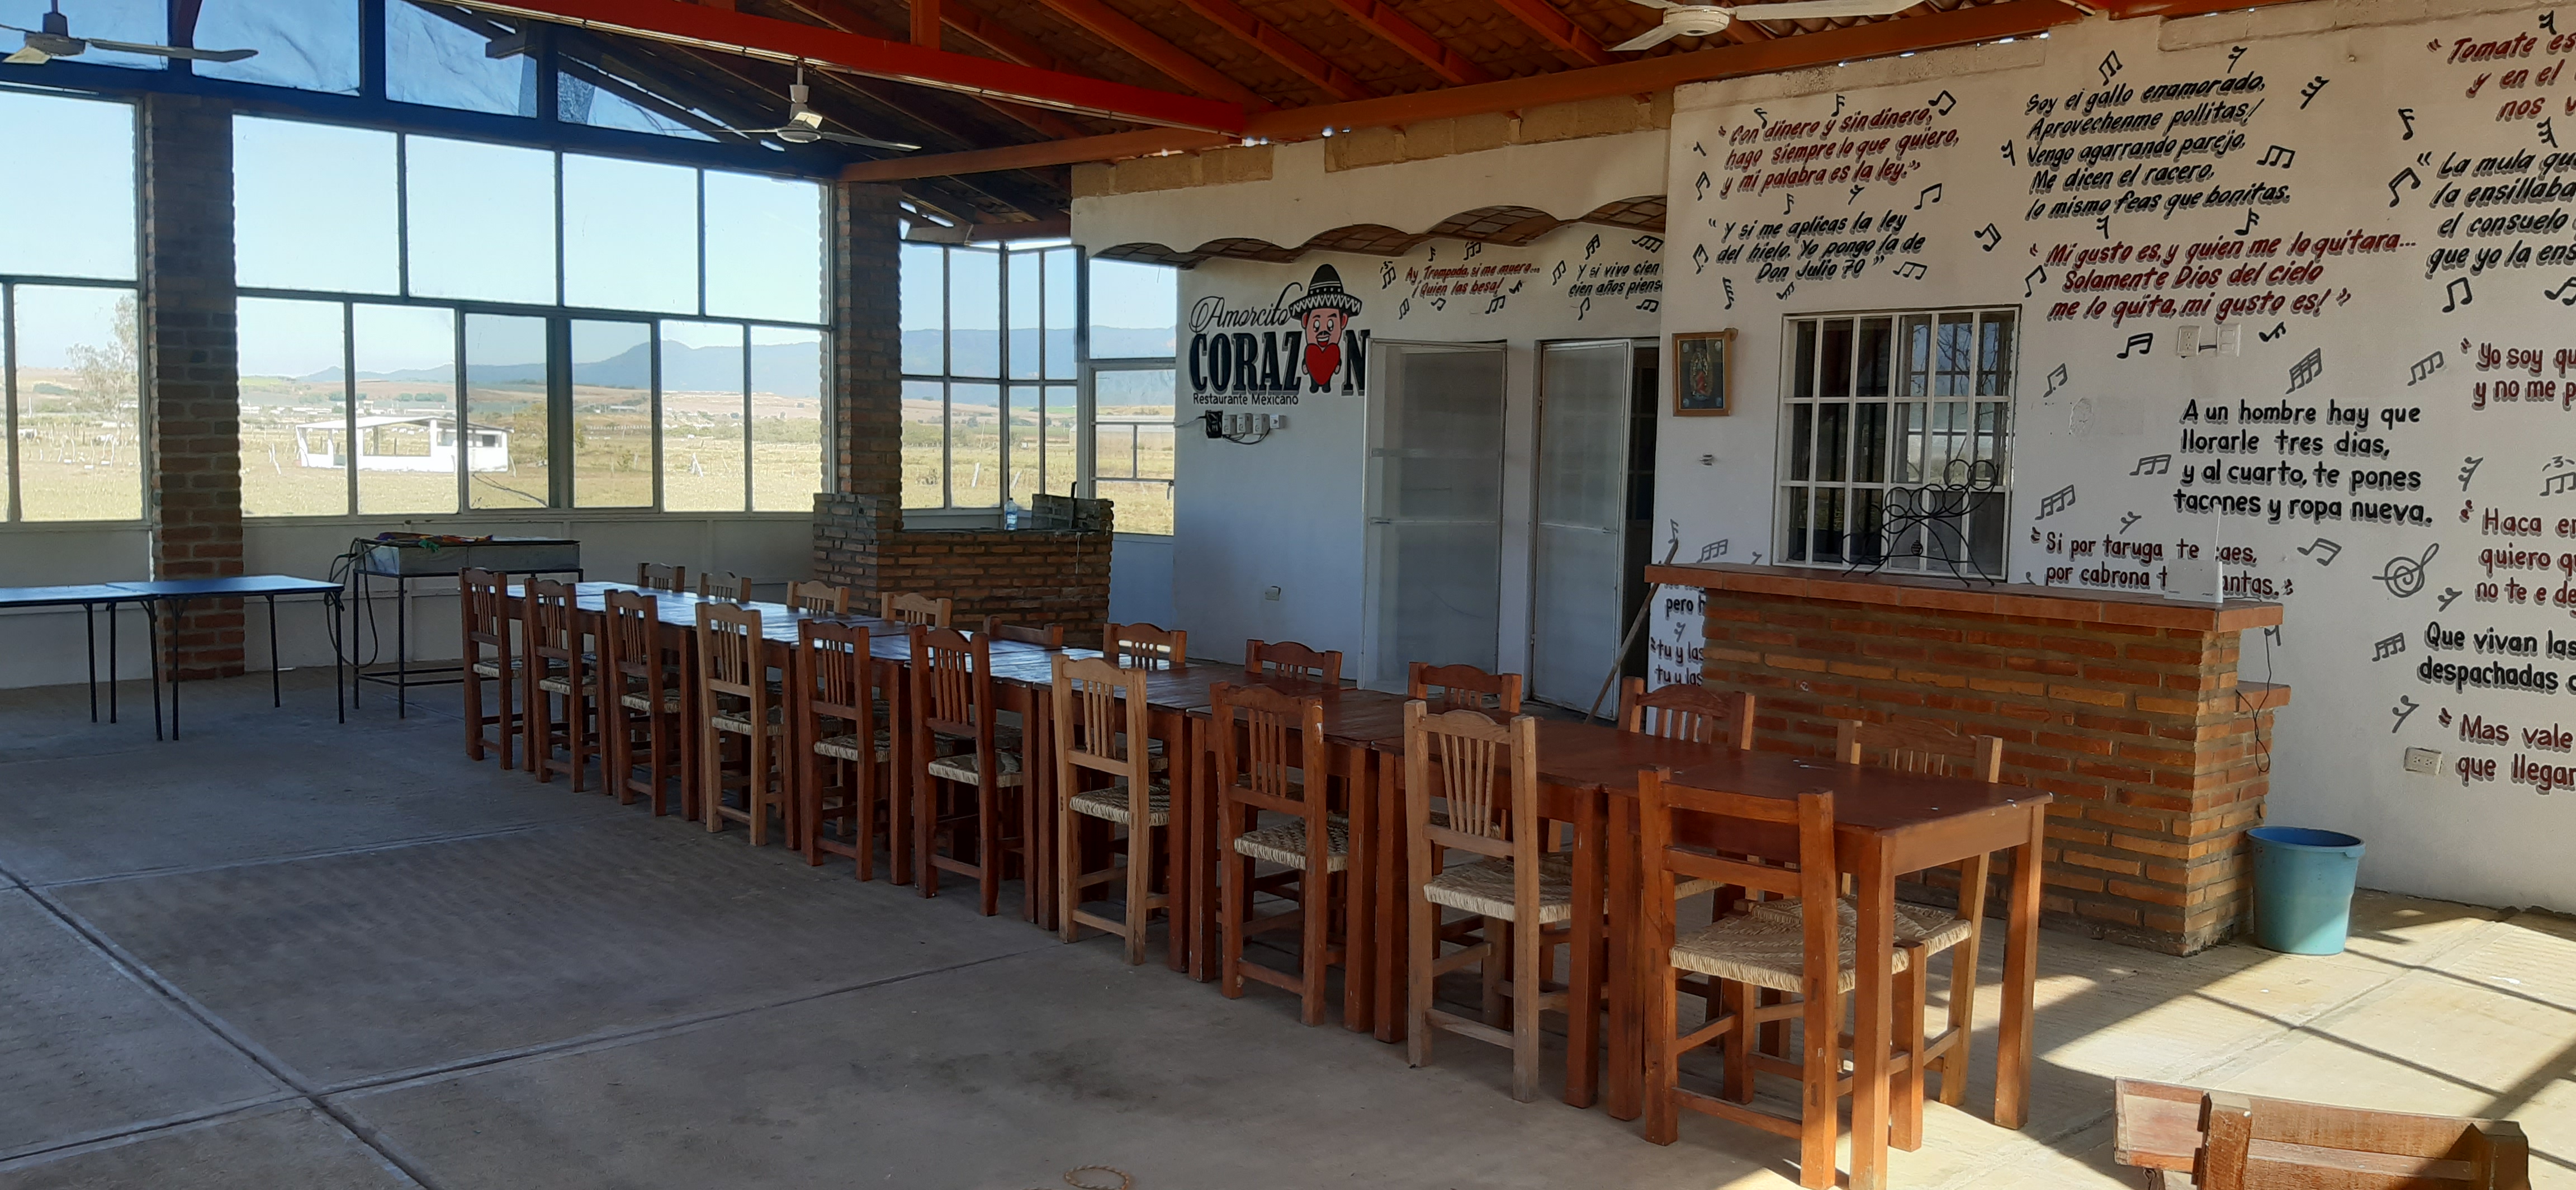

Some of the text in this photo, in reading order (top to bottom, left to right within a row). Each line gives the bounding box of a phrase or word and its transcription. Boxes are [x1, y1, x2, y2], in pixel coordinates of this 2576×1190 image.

[2024, 94, 2058, 117] Soy
[2082, 83, 2133, 116] gallo
[2141, 70, 2265, 102] enamorado,
[2466, 59, 2565, 98] y en el
[1763, 120, 1820, 141] dinero
[1820, 120, 1836, 140] y
[1839, 111, 1869, 133] sin
[1868, 107, 1932, 130] dinero,
[2026, 98, 2264, 145] Aprovechenme pollitas!
[2496, 97, 2545, 121] nos
[1725, 126, 1959, 172] hago siempre lo que quiero,
[2026, 130, 2246, 171] Vengo agarrando parejo,
[2471, 148, 2536, 177] mula
[1720, 177, 1733, 200] y
[1737, 169, 1761, 192] mi
[1758, 166, 1827, 197] palabra
[1828, 166, 1850, 183] es
[1852, 160, 1873, 182] la
[2029, 163, 2214, 194] Me dicen el racero,
[2429, 176, 2576, 208] la ensillaba
[2025, 183, 2290, 221] lo mismo feas que bonitas.
[1739, 210, 1906, 241] si me aplicas la ley
[2437, 207, 2569, 238] el consuelo
[1716, 244, 1744, 265] del
[1798, 239, 1819, 259] Yo
[1821, 240, 1873, 261] pongo
[1876, 234, 1898, 256] la
[1901, 233, 1925, 253] de
[2075, 244, 2133, 271] gusto
[2184, 235, 2243, 268] quien
[2247, 237, 2281, 259] me
[2289, 231, 2309, 256] lo
[2425, 247, 2469, 280] que
[2470, 247, 2502, 276] yo
[2504, 240, 2531, 268] la
[1405, 267, 1418, 285] Ay
[1424, 264, 1469, 283] Trompuda,
[1470, 263, 1481, 277] si
[1480, 265, 1497, 276] me
[1576, 260, 1660, 281] Y si vivo cien
[1755, 262, 1788, 284] Don
[1795, 259, 1838, 280] Julio
[2063, 259, 2324, 293] Solamente Dios del cielo
[1451, 281, 1468, 295] las
[1470, 277, 1505, 296] besa!
[1569, 281, 1593, 298] cien
[1595, 280, 1625, 295] años
[1189, 282, 1303, 333] Amorcito
[2047, 299, 2079, 321] me
[2082, 296, 2107, 319] lo
[2111, 293, 2178, 328] quita,
[2180, 293, 2211, 317] mi
[2214, 292, 2285, 324] gusto
[2506, 348, 2543, 377] soy
[1193, 393, 1299, 405] Restaurante Mexicano
[2471, 380, 2556, 410] y no me
[2180, 399, 2421, 431] A un hombre hay que
[2180, 429, 2390, 460] llorarle tres dias,
[2180, 459, 2422, 495] y al cuarto, te pones
[2268, 498, 2281, 523] y
[2288, 498, 2342, 524] ropa
[2351, 501, 2432, 526] nueva.
[2068, 536, 2096, 562] por
[2103, 534, 2163, 566] taruga
[2176, 538, 2199, 559] te
[2478, 542, 2551, 579] quiero
[2045, 561, 2151, 590] por cabrona
[2475, 582, 2498, 602] no
[2504, 577, 2527, 604] te
[2534, 587, 2546, 605] e
[1665, 598, 1693, 621] pero
[2425, 621, 2576, 660] Que vivan las
[1676, 646, 1683, 667] y
[1655, 664, 1671, 684] tu
[2417, 655, 2558, 695] despachadas
[2522, 723, 2573, 753] vale
[2455, 757, 2497, 787] que
